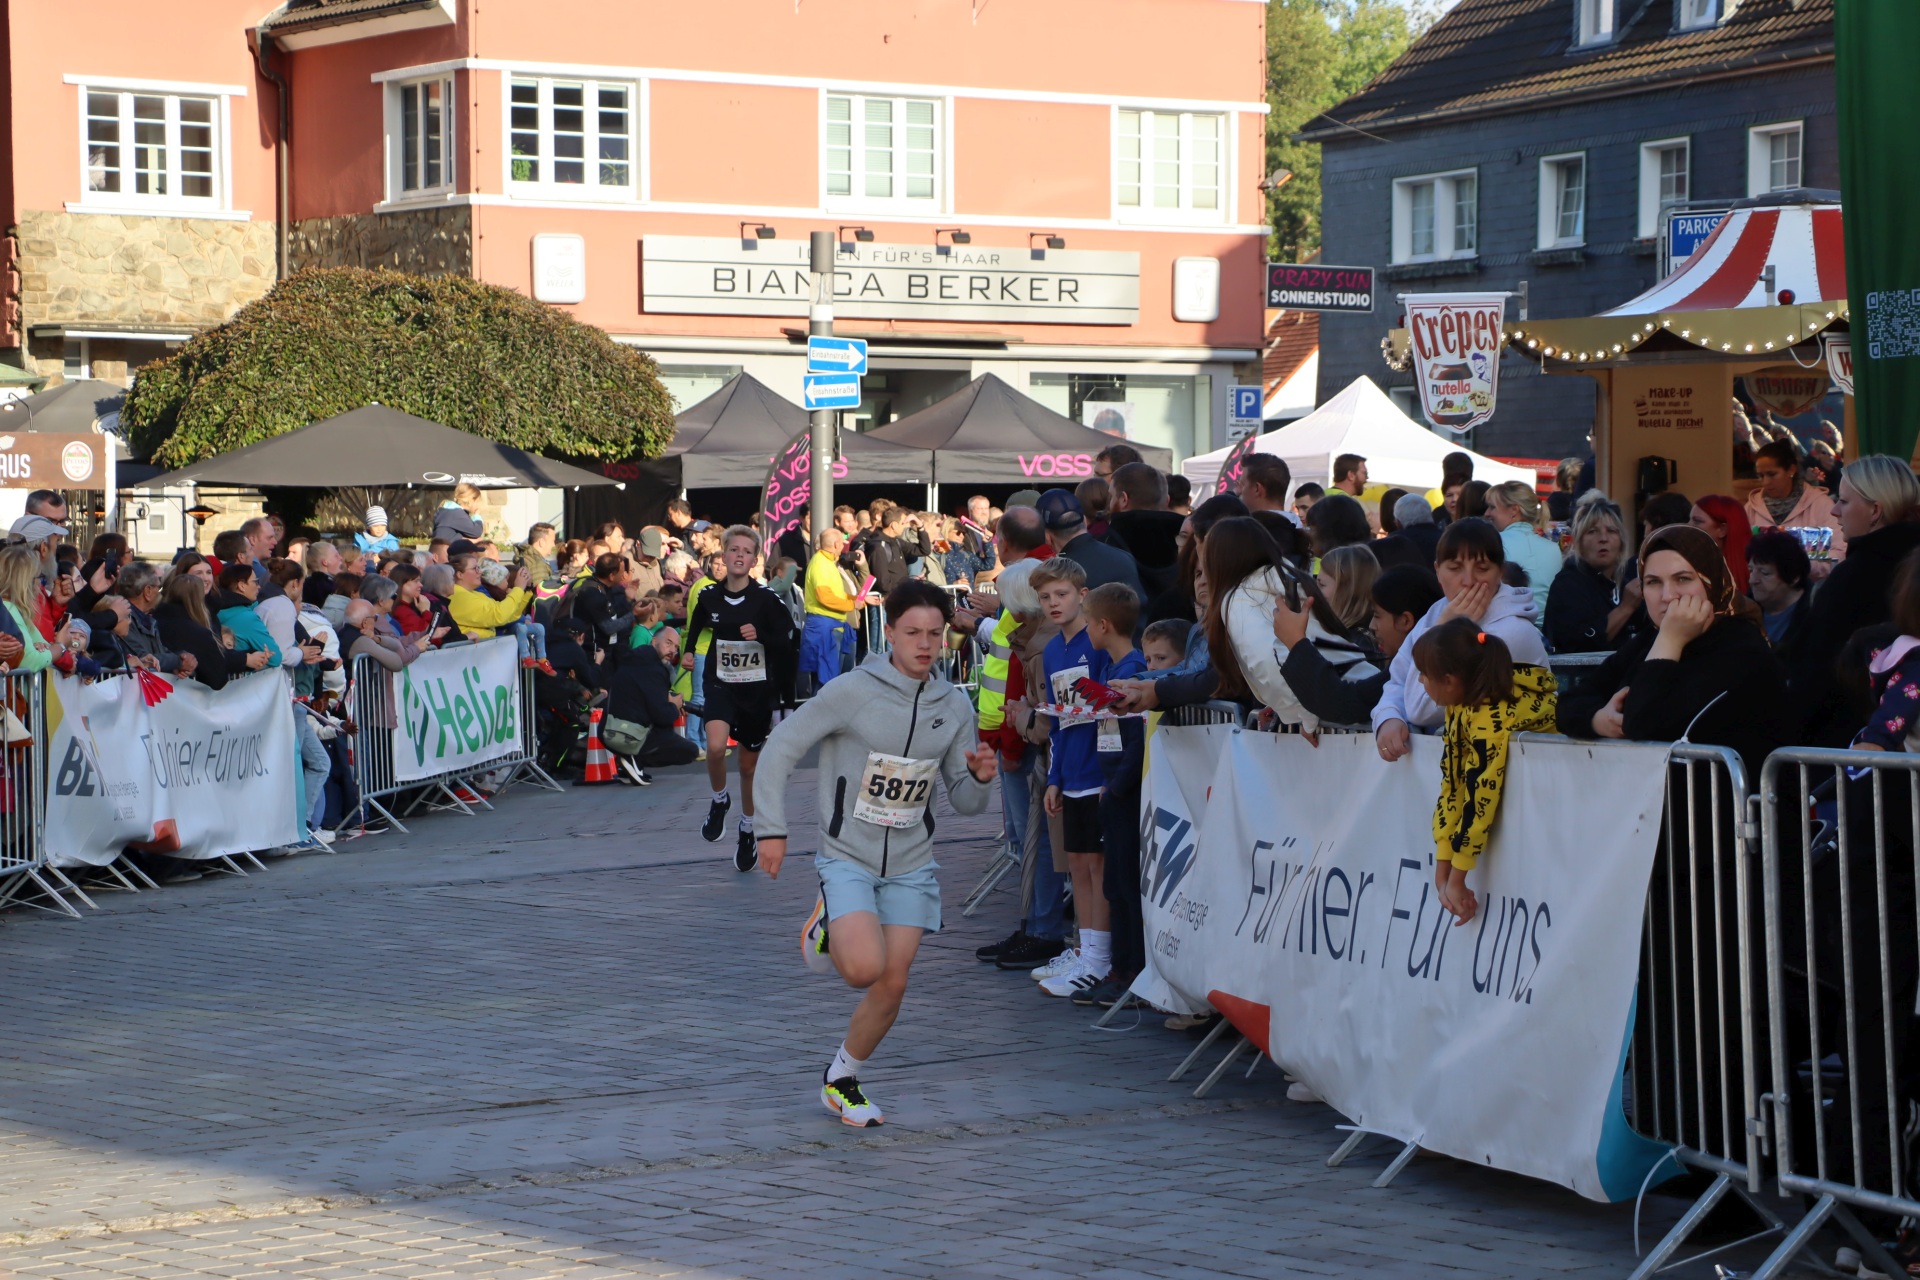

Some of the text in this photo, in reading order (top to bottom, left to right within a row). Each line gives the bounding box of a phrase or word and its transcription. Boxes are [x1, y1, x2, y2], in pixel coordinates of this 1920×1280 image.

[1678, 217, 1722, 235] PARKS
[713, 267, 1080, 303] BIANCA BERKER
[1271, 268, 1371, 290] CRAZY SUN
[1271, 289, 1371, 307] SONNENSTUDIO
[1411, 305, 1500, 361] Crêpes
[811, 348, 851, 361] Einbahnstraße
[812, 385, 855, 397] Einbahnstraße
[1431, 379, 1471, 396] nutella
[1240, 391, 1256, 416] P
[602, 463, 640, 479] VOSS
[1017, 453, 1093, 477] VOSS
[721, 652, 760, 668] 5674
[424, 665, 515, 758] Helios
[204, 725, 237, 783] Für
[237, 731, 269, 780] uns.
[55, 735, 110, 798] BE
[868, 773, 929, 803] 5872
[1140, 800, 1201, 909] BEW
[1235, 836, 1304, 946] Für
[1472, 892, 1551, 1005] uns.
